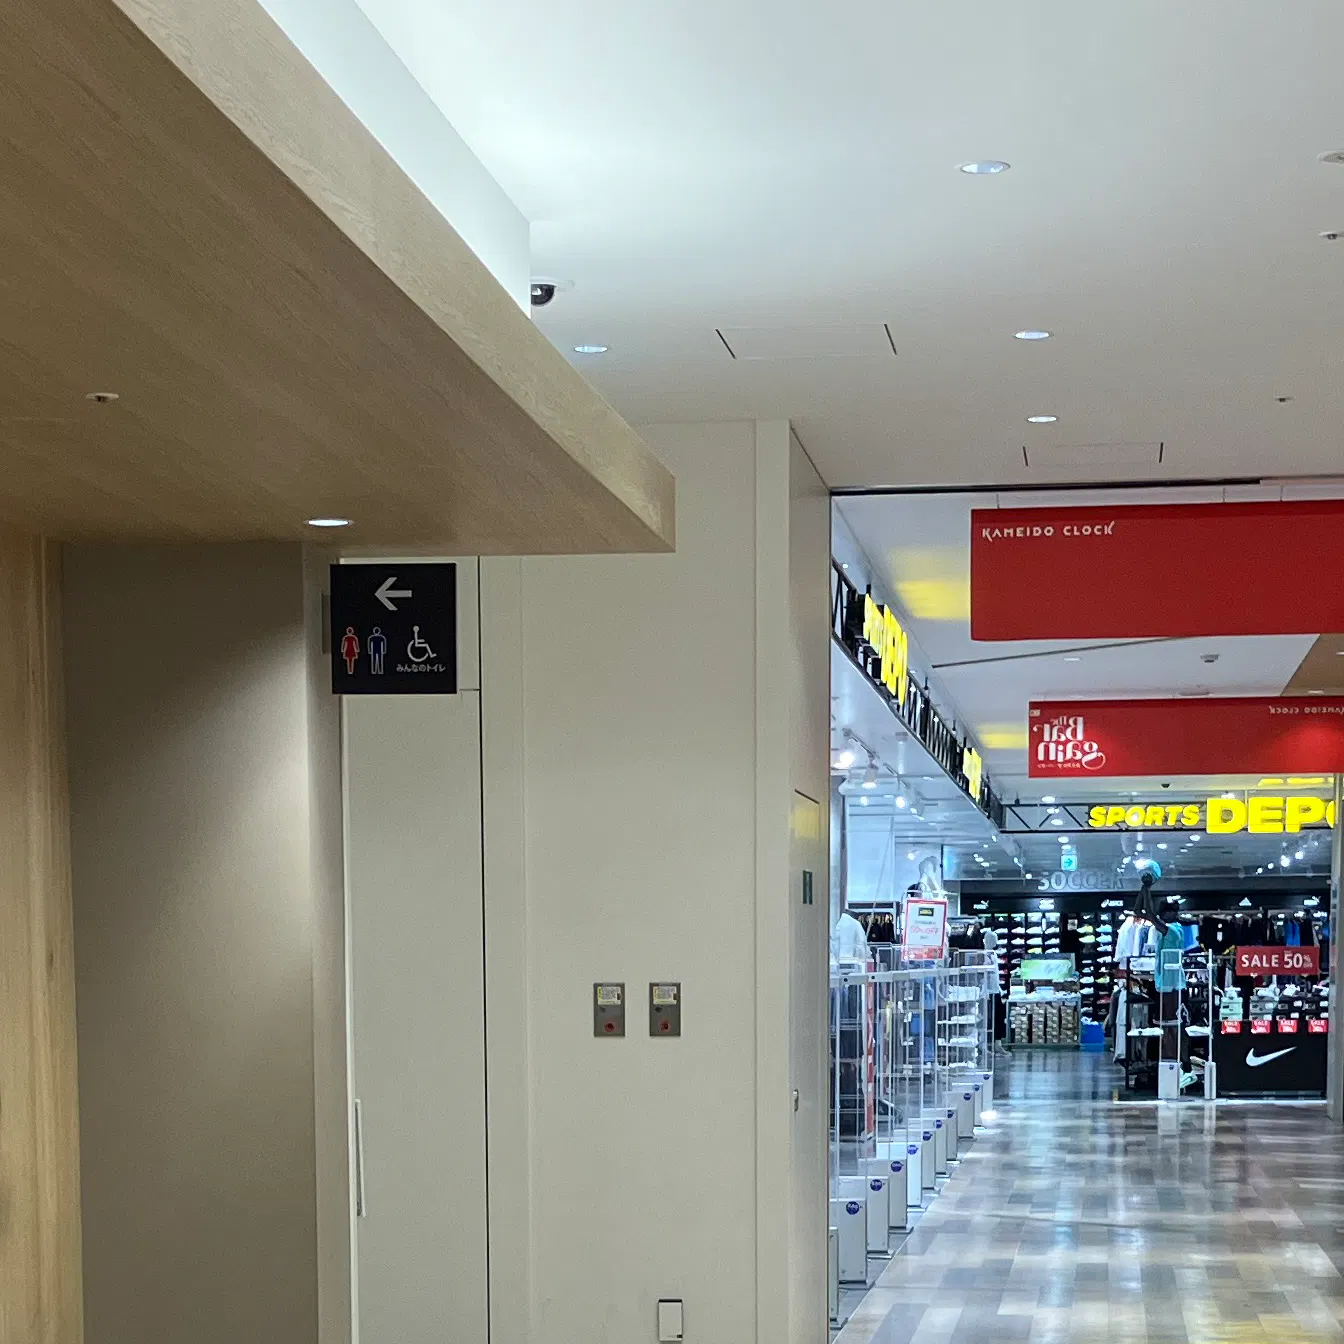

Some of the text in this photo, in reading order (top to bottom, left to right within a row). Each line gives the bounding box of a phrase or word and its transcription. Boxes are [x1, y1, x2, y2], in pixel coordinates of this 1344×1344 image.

[982, 521, 1115, 542] KAMEIDO CLOCK
[396, 664, 446, 673] みんなのトイレ
[1088, 796, 1334, 834] SPORTS DEP
[1241, 954, 1278, 968] SALE
